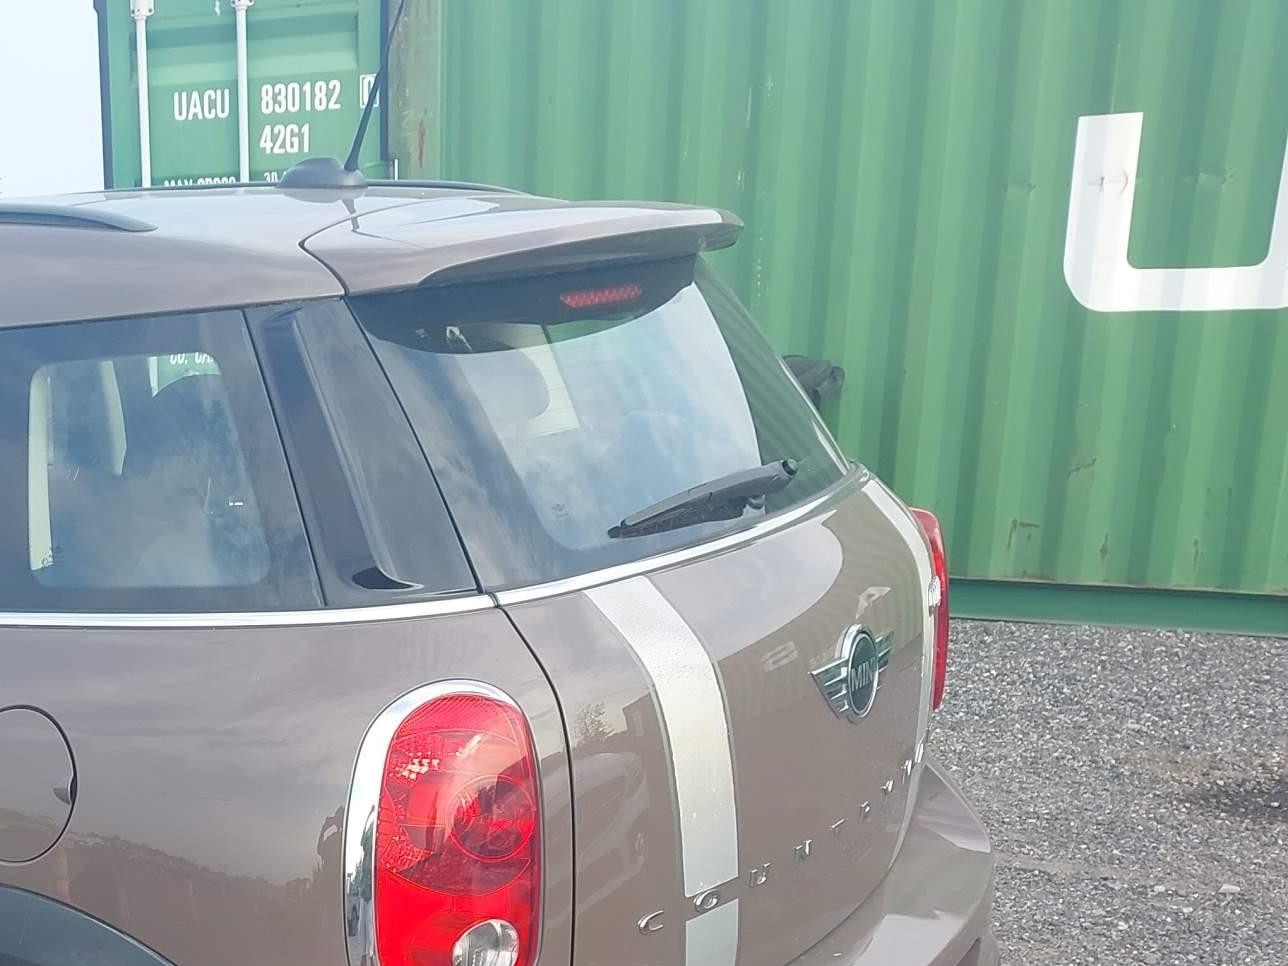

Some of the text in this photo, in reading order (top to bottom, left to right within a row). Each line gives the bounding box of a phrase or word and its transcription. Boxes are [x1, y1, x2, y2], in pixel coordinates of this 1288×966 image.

[173, 88, 230, 121] UACU
[261, 79, 341, 115] 830182
[259, 122, 310, 154] 42G1
